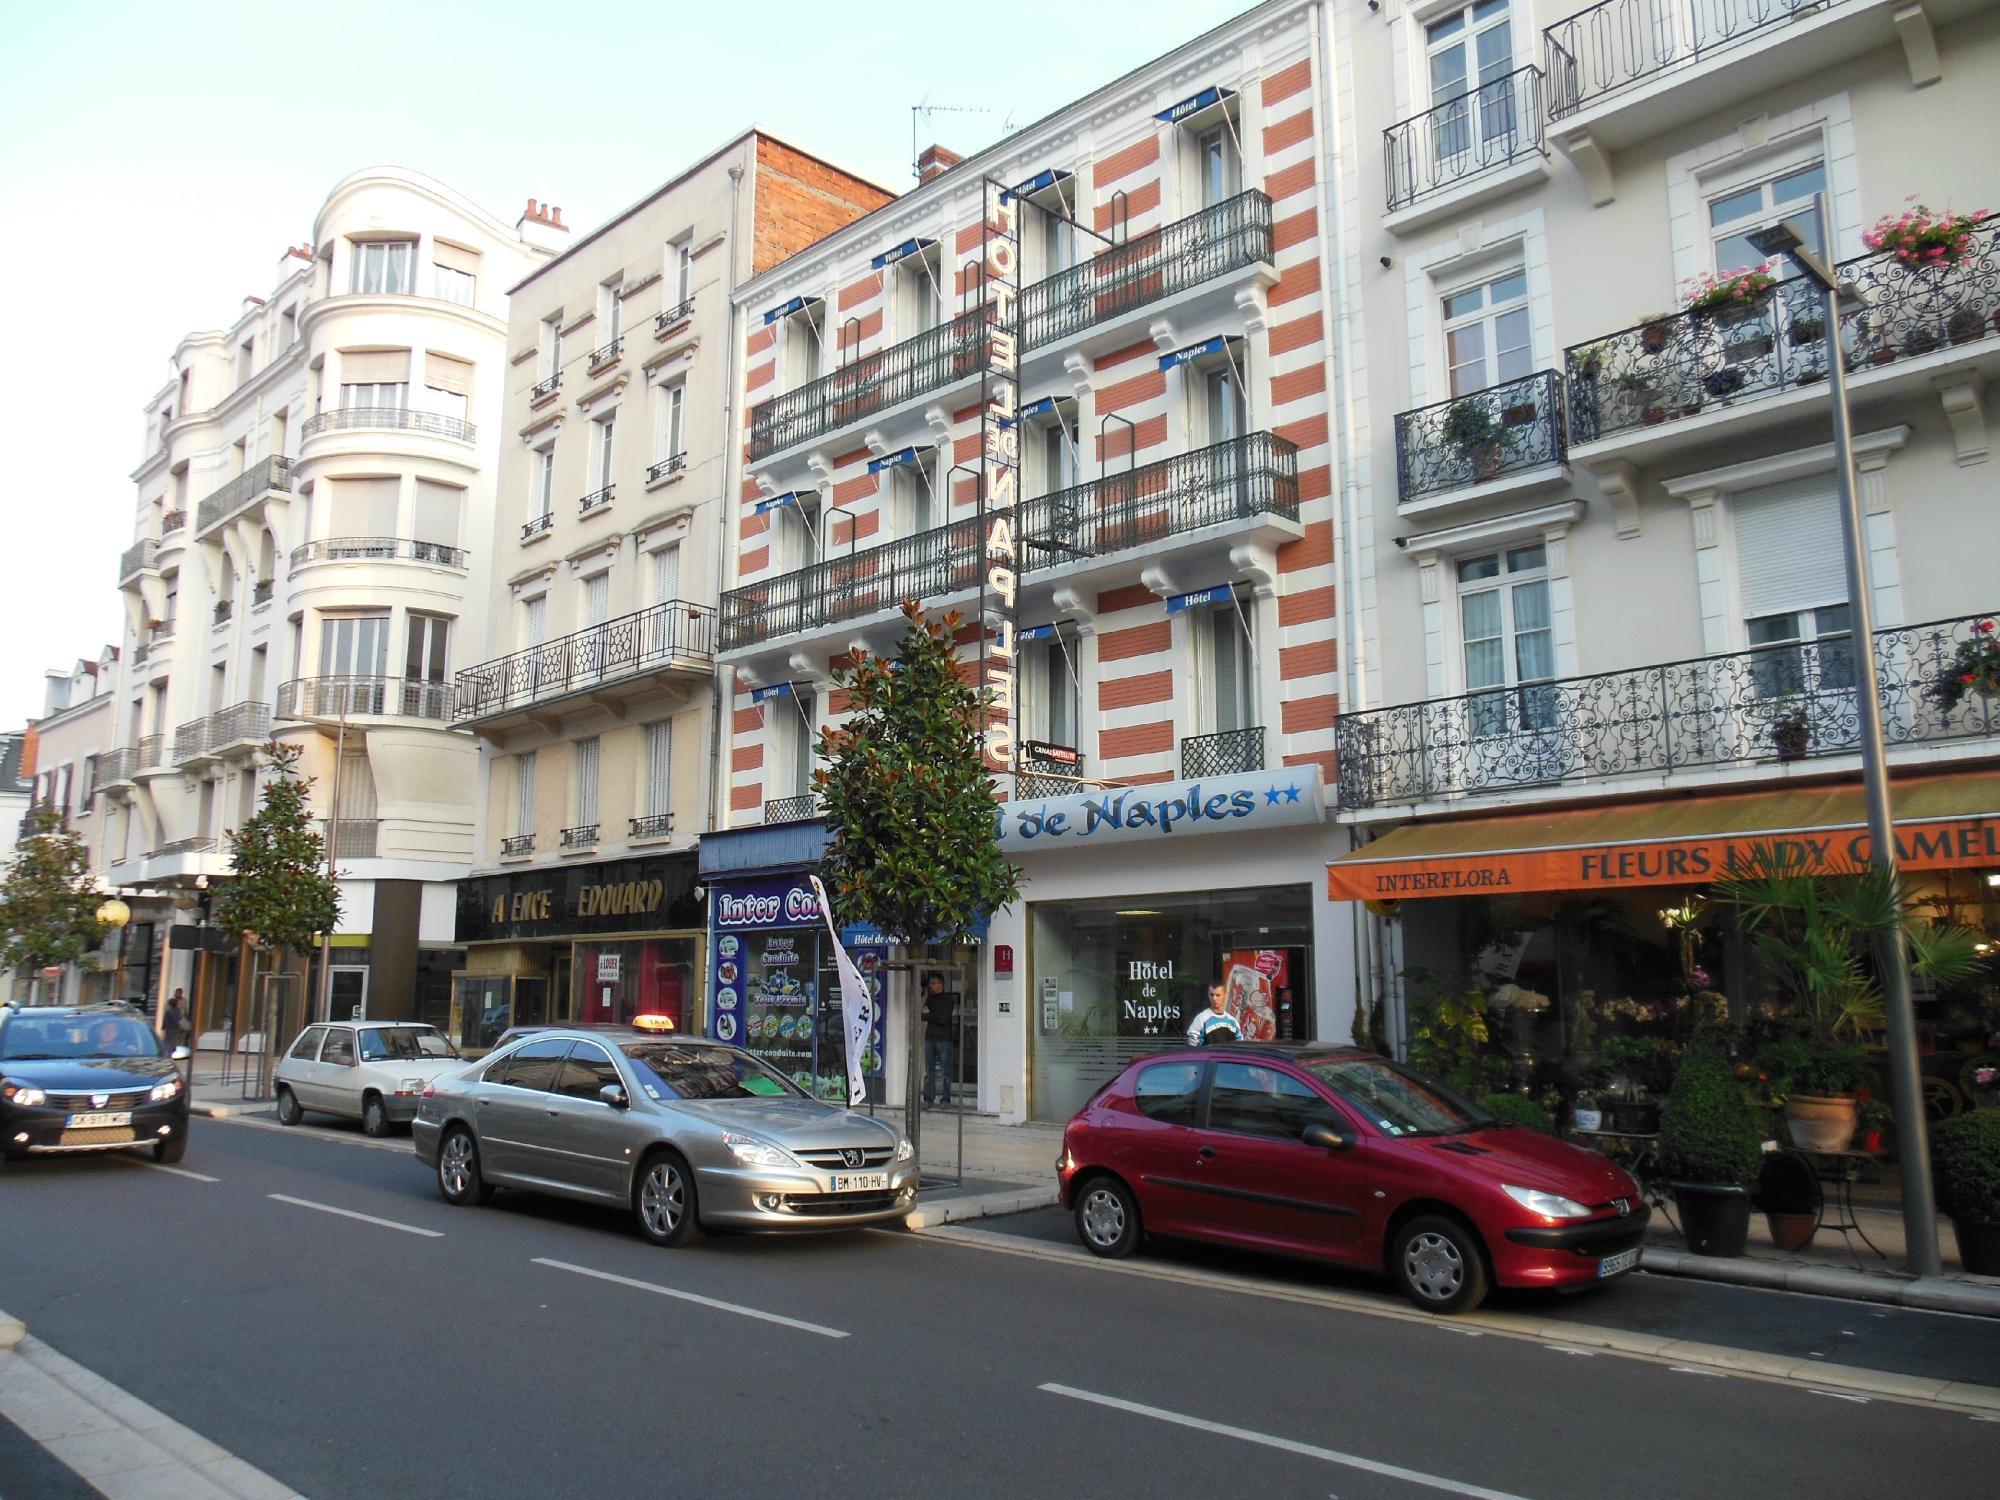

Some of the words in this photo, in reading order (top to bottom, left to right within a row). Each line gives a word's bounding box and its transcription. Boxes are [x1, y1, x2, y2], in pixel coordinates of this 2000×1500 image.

[1171, 99, 1197, 118] Hôtel
[1175, 343, 1208, 363] Naples
[1184, 591, 1211, 607] Hôtel
[1017, 804, 1072, 839] de
[1077, 784, 1255, 836] Naples
[1580, 846, 1711, 881] FLEURS
[1725, 838, 1831, 873] LADY
[1376, 867, 1512, 893] INTERFLORA
[577, 879, 664, 917] EDOUARD
[719, 894, 780, 925] Inter
[854, 933, 874, 945] Hôtel
[874, 933, 885, 944] de
[1128, 960, 1174, 980] Hôtel
[1142, 983, 1157, 997] de
[1124, 1000, 1181, 1023] Naples
